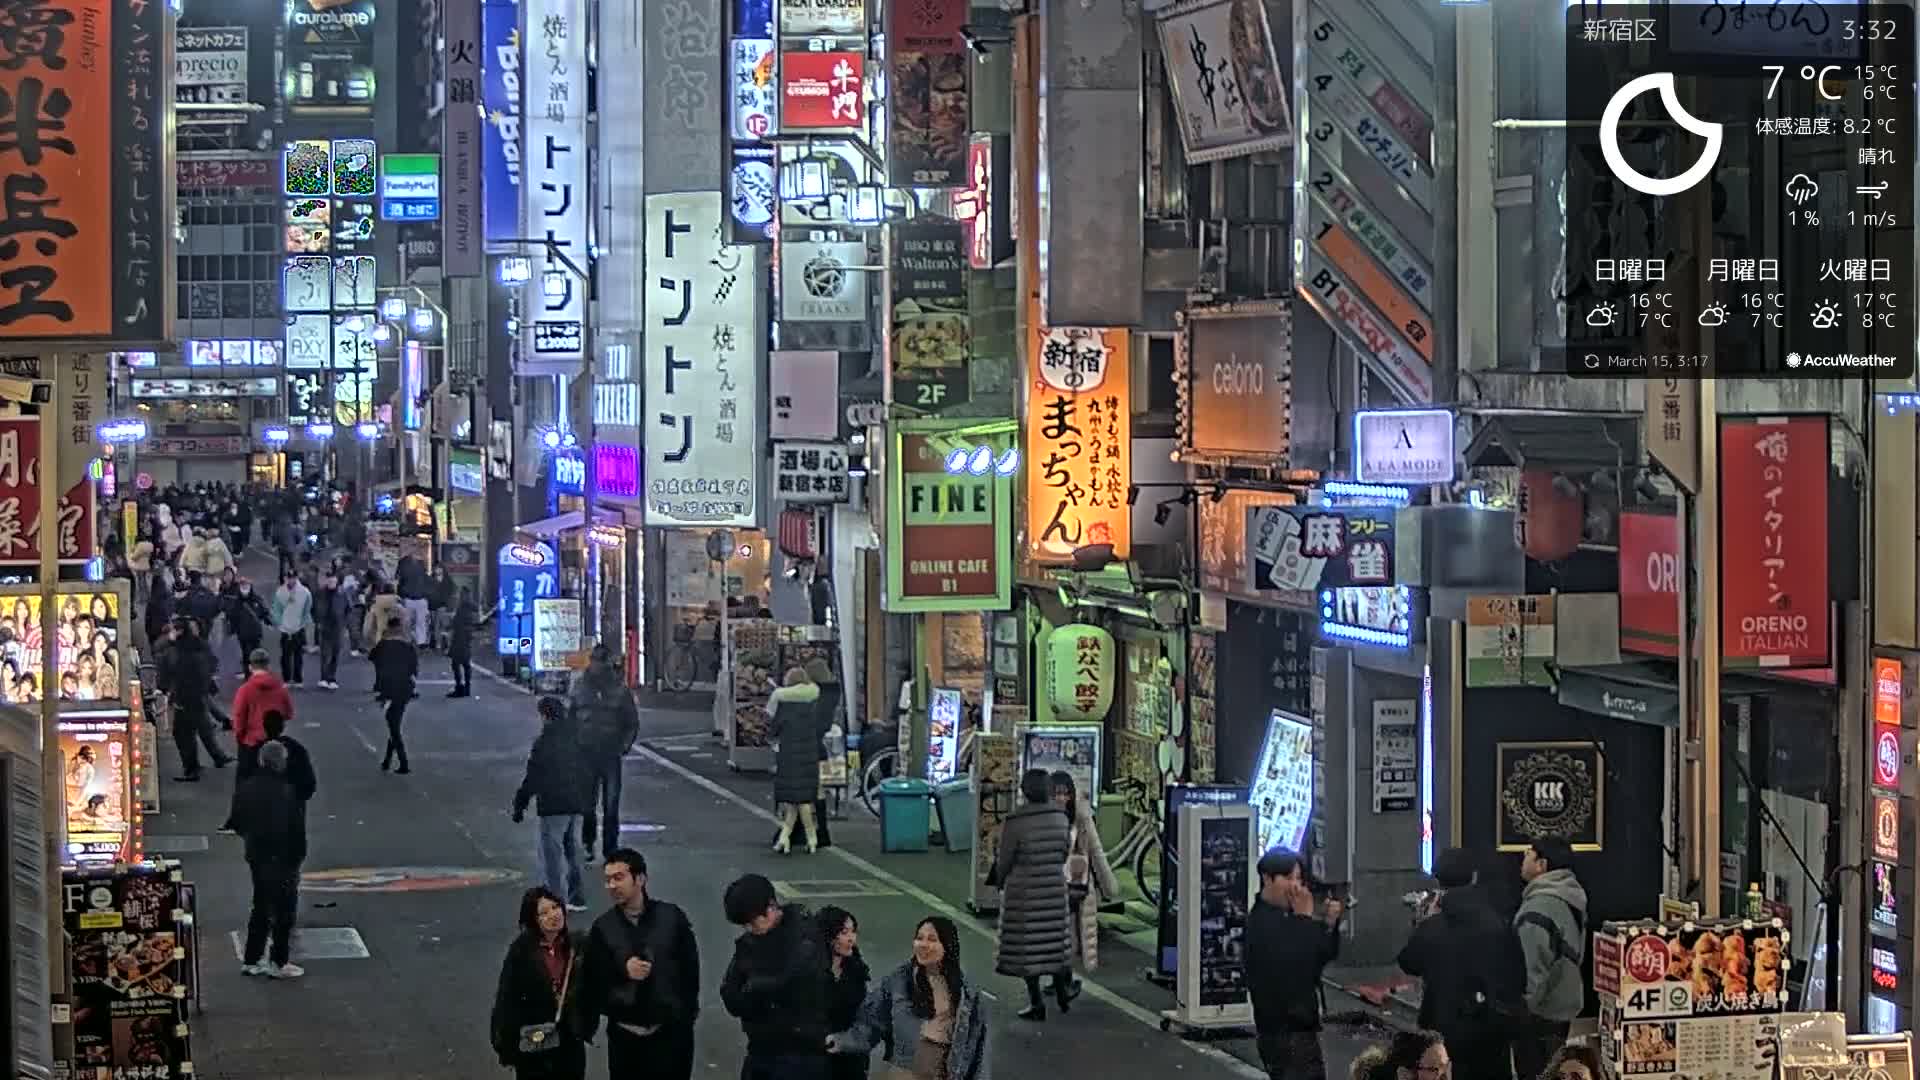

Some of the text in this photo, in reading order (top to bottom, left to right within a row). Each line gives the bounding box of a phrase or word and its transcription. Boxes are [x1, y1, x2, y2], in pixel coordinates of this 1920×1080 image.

[1313, 21, 1335, 41] 5
[450, 40, 476, 103] 火鍋
[1314, 74, 1333, 91] 4
[1314, 122, 1334, 141] 3
[1312, 172, 1333, 193] 2
[1311, 268, 1339, 298] B1
[660, 210, 692, 462] トントン
[1044, 339, 1103, 373] 新宿
[1213, 352, 1264, 394] celona
[917, 385, 947, 404] 2F
[1394, 428, 1415, 450] A
[779, 450, 844, 471] 酒場心
[1041, 395, 1086, 544] まっちゃん
[779, 475, 844, 492] 新宿本店
[911, 485, 987, 513] FINE
[1350, 519, 1390, 534] フリー
[1754, 431, 1790, 604] 俺のイタリアン
[910, 559, 988, 575] ONLINE CAFE
[1741, 616, 1807, 633] ORENO
[1740, 633, 1809, 651] ITALIAN
[1075, 636, 1102, 713] 鉄なべ餃子
[1534, 782, 1564, 800] KK
[1628, 989, 1661, 1011] 4F
[1696, 990, 1778, 1013] 炭火焼き鳥
